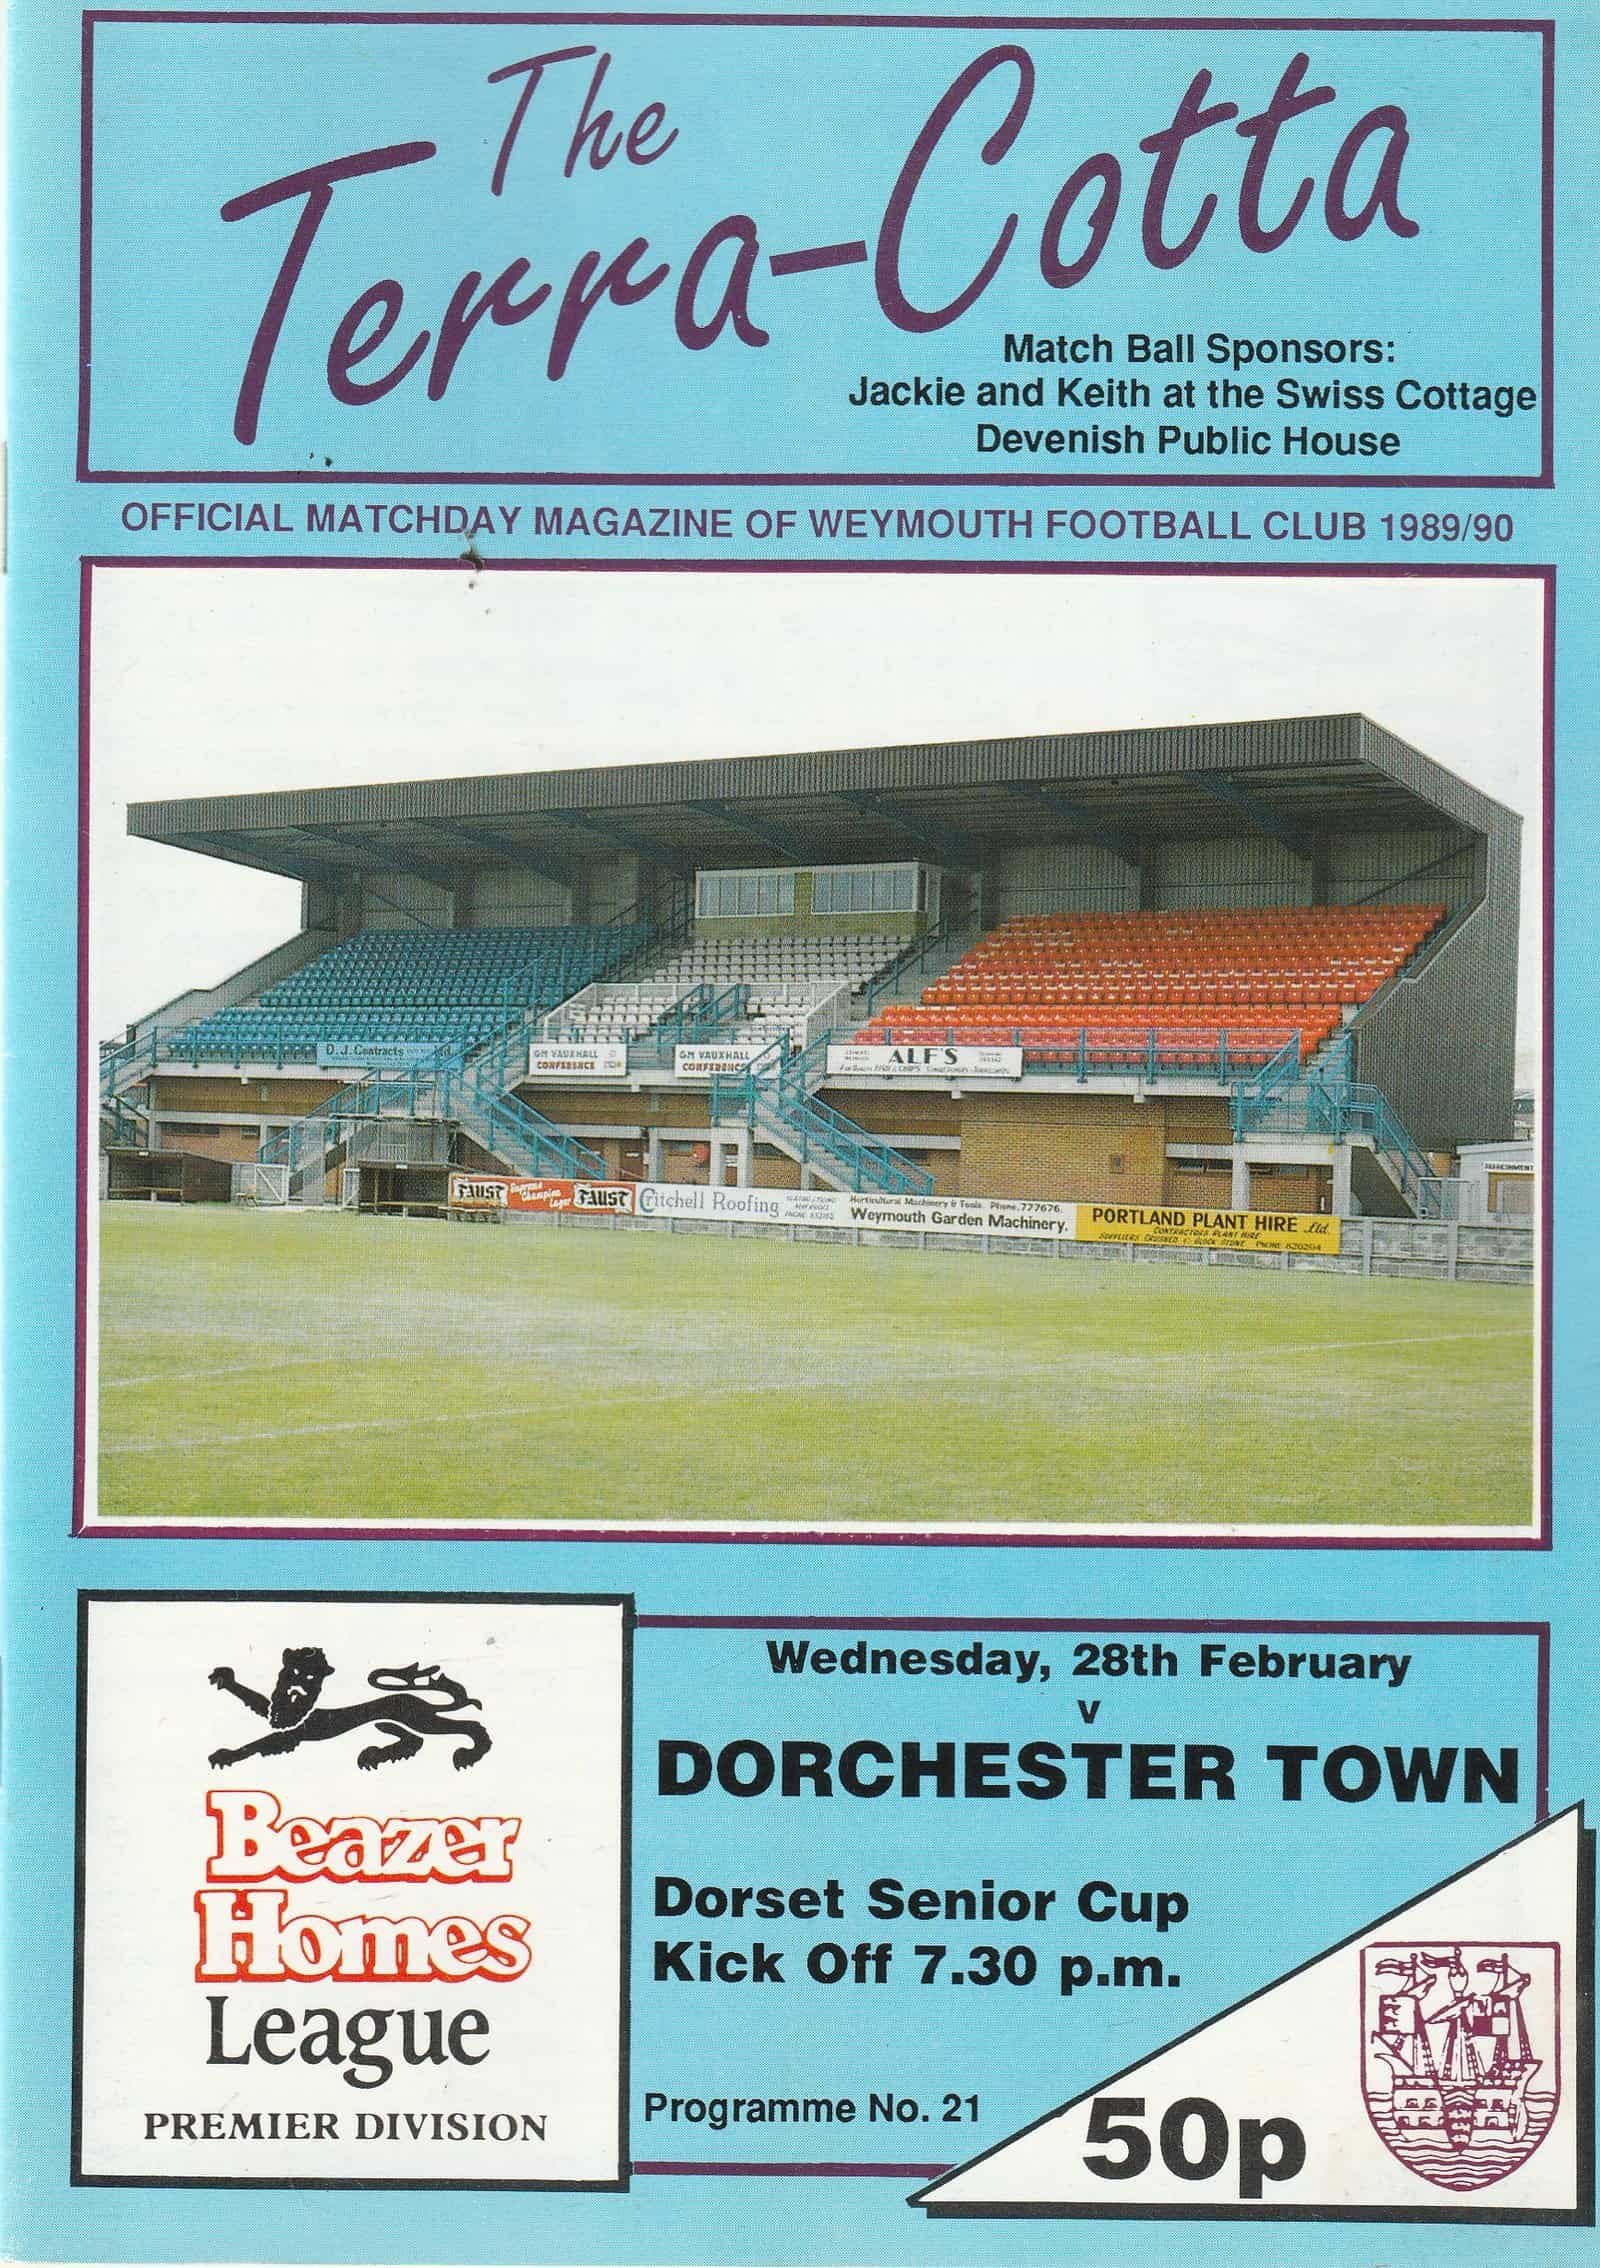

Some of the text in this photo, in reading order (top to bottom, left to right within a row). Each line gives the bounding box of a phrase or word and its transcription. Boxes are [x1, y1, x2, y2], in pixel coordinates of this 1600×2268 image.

[488, 46, 678, 196] The
[220, 45, 1420, 446] Terra-Cotta
[1005, 333, 1394, 368] Match Ball Sponsors:
[849, 376, 1536, 417] Jackie and Keith at the Swiss Cottage
[977, 424, 1400, 456] Devenish Public House
[122, 503, 1513, 541] OFFICIAL MATCHDAY MAGAZINE OF WEYMOUTH FOOTBALL CLUB 1989/90
[537, 1061, 595, 1070] CONFERENCE
[551, 1050, 598, 1058] VAUXHALL
[700, 1051, 750, 1060] VAUXHALL
[889, 1048, 958, 1065] ALF'S
[458, 1183, 505, 1200] FAUST
[579, 1188, 629, 1206] FAUST
[639, 1187, 780, 1218] Critchell Roofing
[850, 1207, 926, 1224] Weymouth
[931, 1211, 983, 1226] Garden
[988, 1214, 1068, 1233] Machinery.
[1092, 1207, 1186, 1226] PORTLAND
[1193, 1212, 1248, 1230] PLANT
[1255, 1216, 1297, 1232] HIRE
[766, 1641, 1412, 1687] Wednesday, 28th February
[1078, 1700, 1100, 1724] v
[658, 1740, 1518, 1803] DORCHESTER TOWN
[206, 1790, 521, 1884] Beazer
[655, 1876, 1188, 1926] Dorset Senior Cup
[194, 1889, 532, 1983] Homes
[654, 1941, 1182, 1996] Kick Off 7.30 p.m.
[206, 1996, 489, 2089] League
[145, 2113, 546, 2141] PREMIER DIVISION
[645, 2093, 978, 2127] Programme No. 21
[1083, 2098, 1305, 2198] 50p
